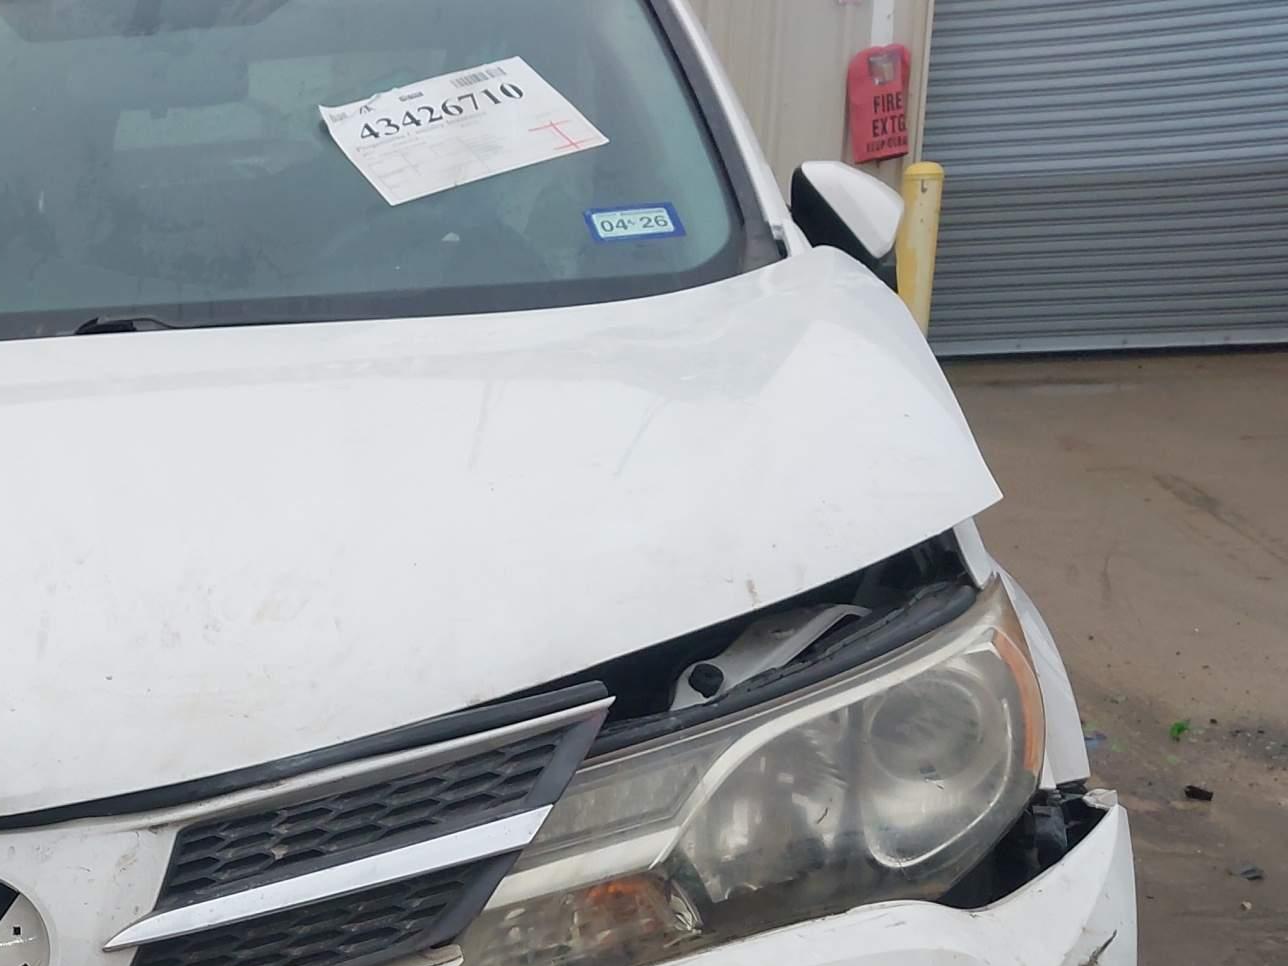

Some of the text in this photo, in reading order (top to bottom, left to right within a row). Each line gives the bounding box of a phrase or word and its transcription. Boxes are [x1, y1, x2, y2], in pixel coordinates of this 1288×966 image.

[359, 81, 525, 141] 43426710
[873, 91, 903, 114] FIRE
[600, 215, 669, 233] 04 26
